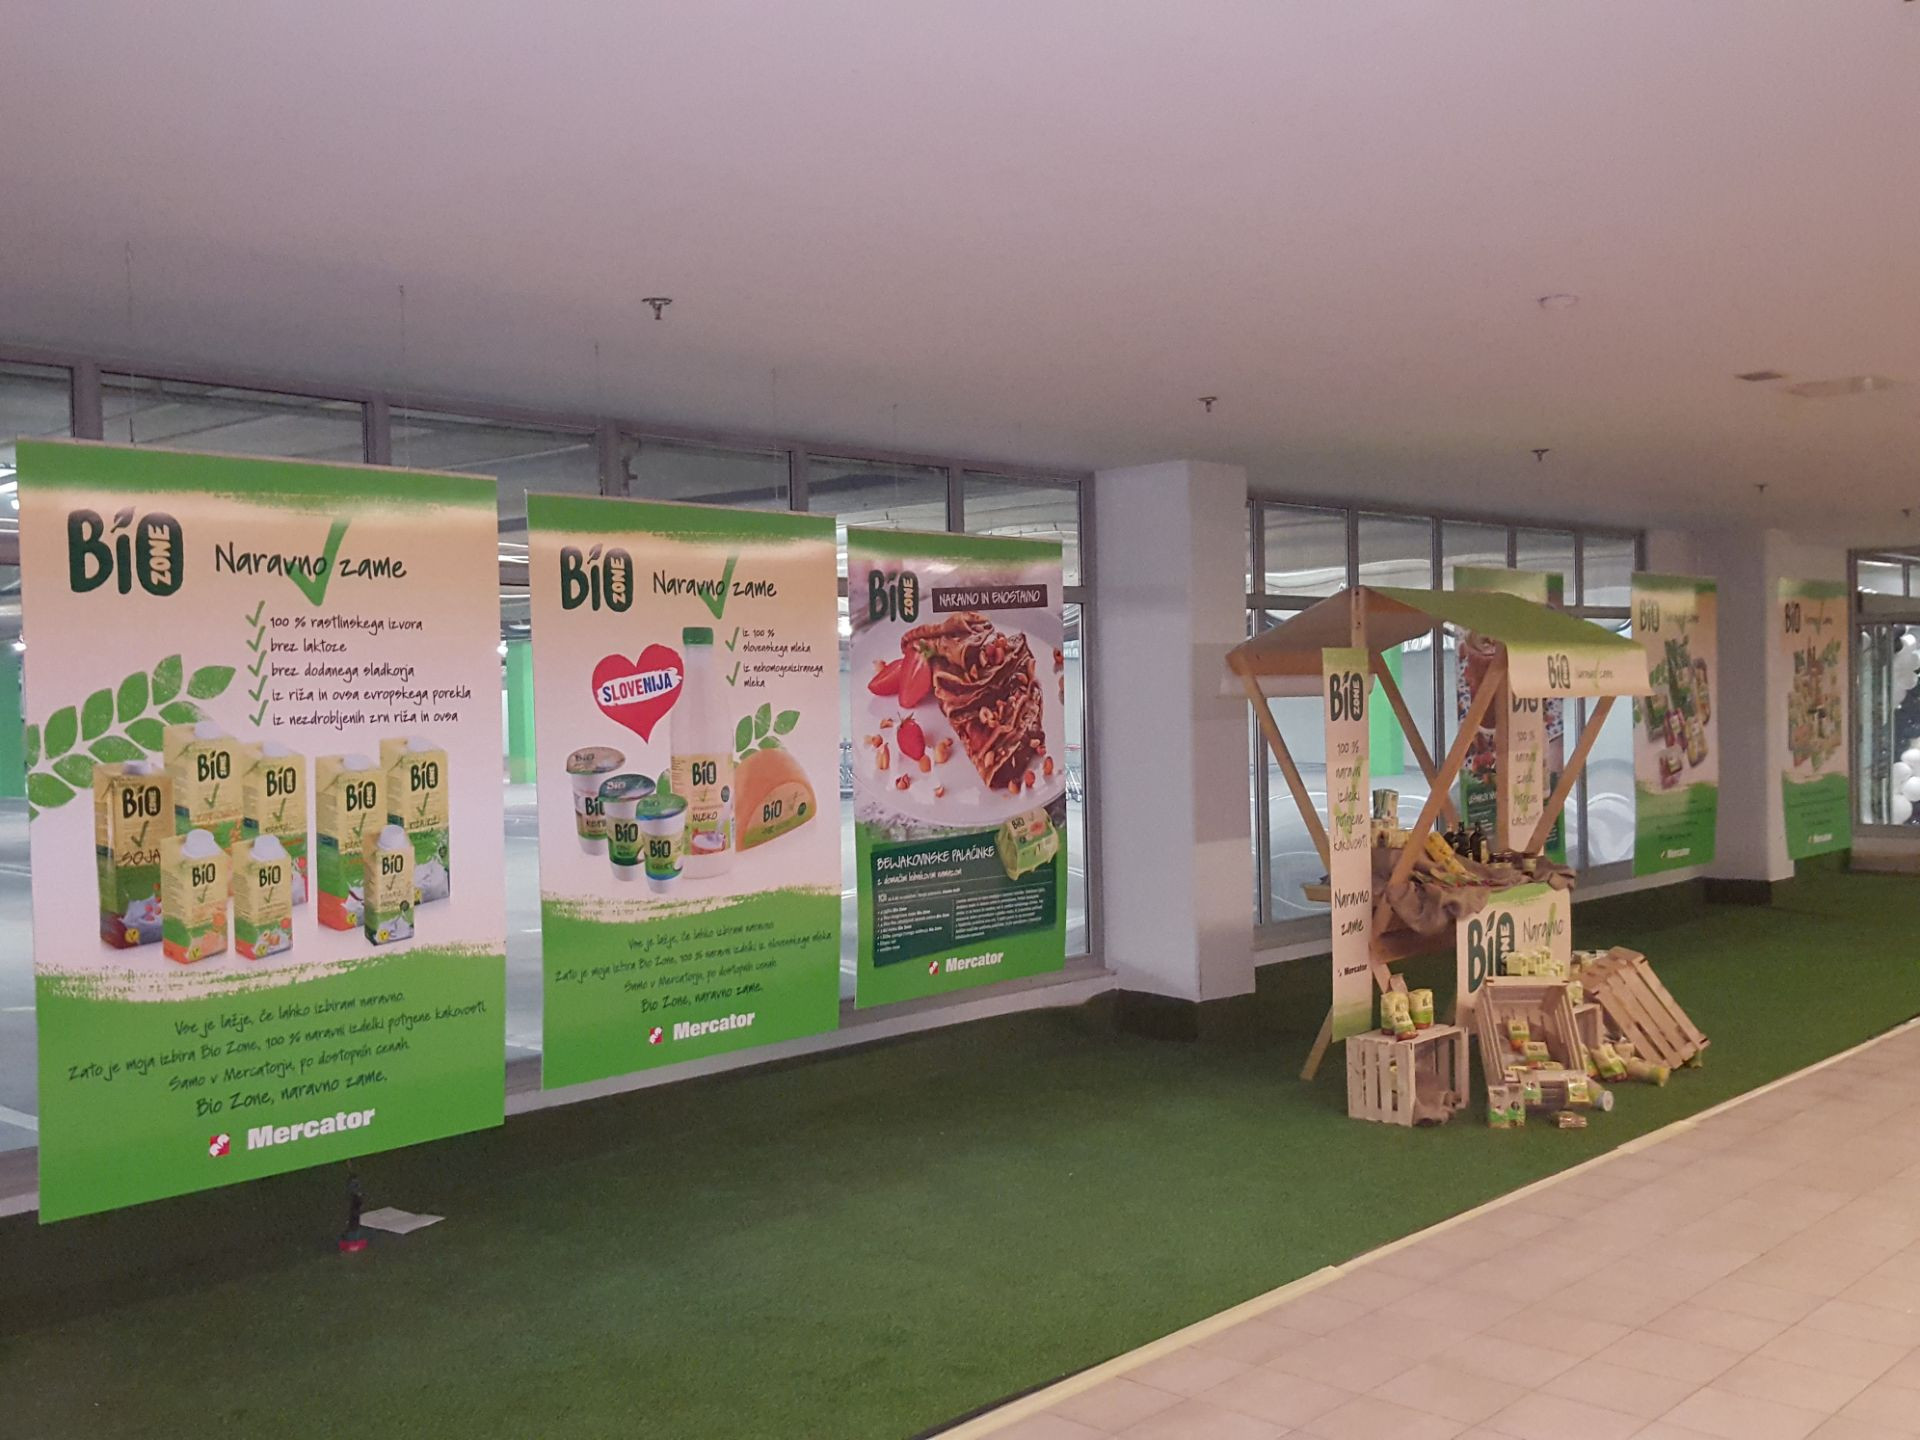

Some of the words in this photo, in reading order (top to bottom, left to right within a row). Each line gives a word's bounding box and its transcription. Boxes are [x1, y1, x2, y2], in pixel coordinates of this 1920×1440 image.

[148, 524, 171, 586] ZONE
[215, 541, 327, 577] Naravno
[340, 556, 408, 580] zame
[611, 556, 626, 604] ZONE
[653, 570, 725, 596] Naravno
[732, 580, 777, 597] zame
[903, 577, 913, 616] ZONE
[981, 592, 990, 604] IN
[270, 616, 289, 628] 100
[294, 616, 306, 627] %
[310, 615, 385, 636] rastlinskega
[388, 617, 423, 631] izvora
[753, 629, 765, 638] 100
[767, 628, 775, 638] %
[270, 638, 299, 652] brez
[303, 638, 347, 653] laktoze
[271, 662, 300, 677] brez
[304, 662, 359, 683] dodanega
[363, 662, 415, 682] sladkorja
[272, 688, 284, 701] iz
[288, 688, 314, 701] riža
[318, 688, 328, 700] in
[332, 690, 360, 700] ovsa
[364, 685, 429, 706] evropskega
[432, 685, 472, 704] porekla
[602, 672, 674, 704] SLOVENIJA
[273, 713, 284, 725] iz
[289, 710, 365, 730] nezdrobljenih
[369, 712, 390, 723] zrn
[394, 710, 417, 722] riža
[420, 709, 430, 721] in
[433, 712, 458, 722] ovsa
[1337, 742, 1349, 754] 100
[1334, 888, 1369, 909] Naravno
[1341, 917, 1364, 936] zame
[946, 952, 1004, 973] Mercator
[175, 1021, 198, 1035] Vse
[199, 1020, 216, 1038] je
[258, 1009, 274, 1023] če
[279, 1005, 310, 1020] lahko
[314, 996, 356, 1014] izbiram
[673, 1012, 755, 1040] Mercator
[68, 1064, 103, 1081] Zato
[103, 1064, 121, 1082] je
[125, 1057, 155, 1076] moja
[159, 1049, 196, 1066] izbira
[200, 1045, 221, 1060] Bio
[265, 1035, 285, 1047] 100
[288, 1033, 301, 1046] %
[305, 1026, 345, 1042] naravni
[350, 1016, 384, 1035] izdelki
[387, 1011, 431, 1033] potrjene
[434, 1000, 487, 1020] kakovosti
[169, 1075, 206, 1091] Samo
[210, 1076, 219, 1084] v
[299, 1057, 313, 1075] po
[196, 1097, 223, 1117] Bio
[229, 1088, 275, 1110] Zone,
[281, 1077, 340, 1100] naravno
[346, 1069, 388, 1089] zame.
[246, 1107, 376, 1150] Mercator
